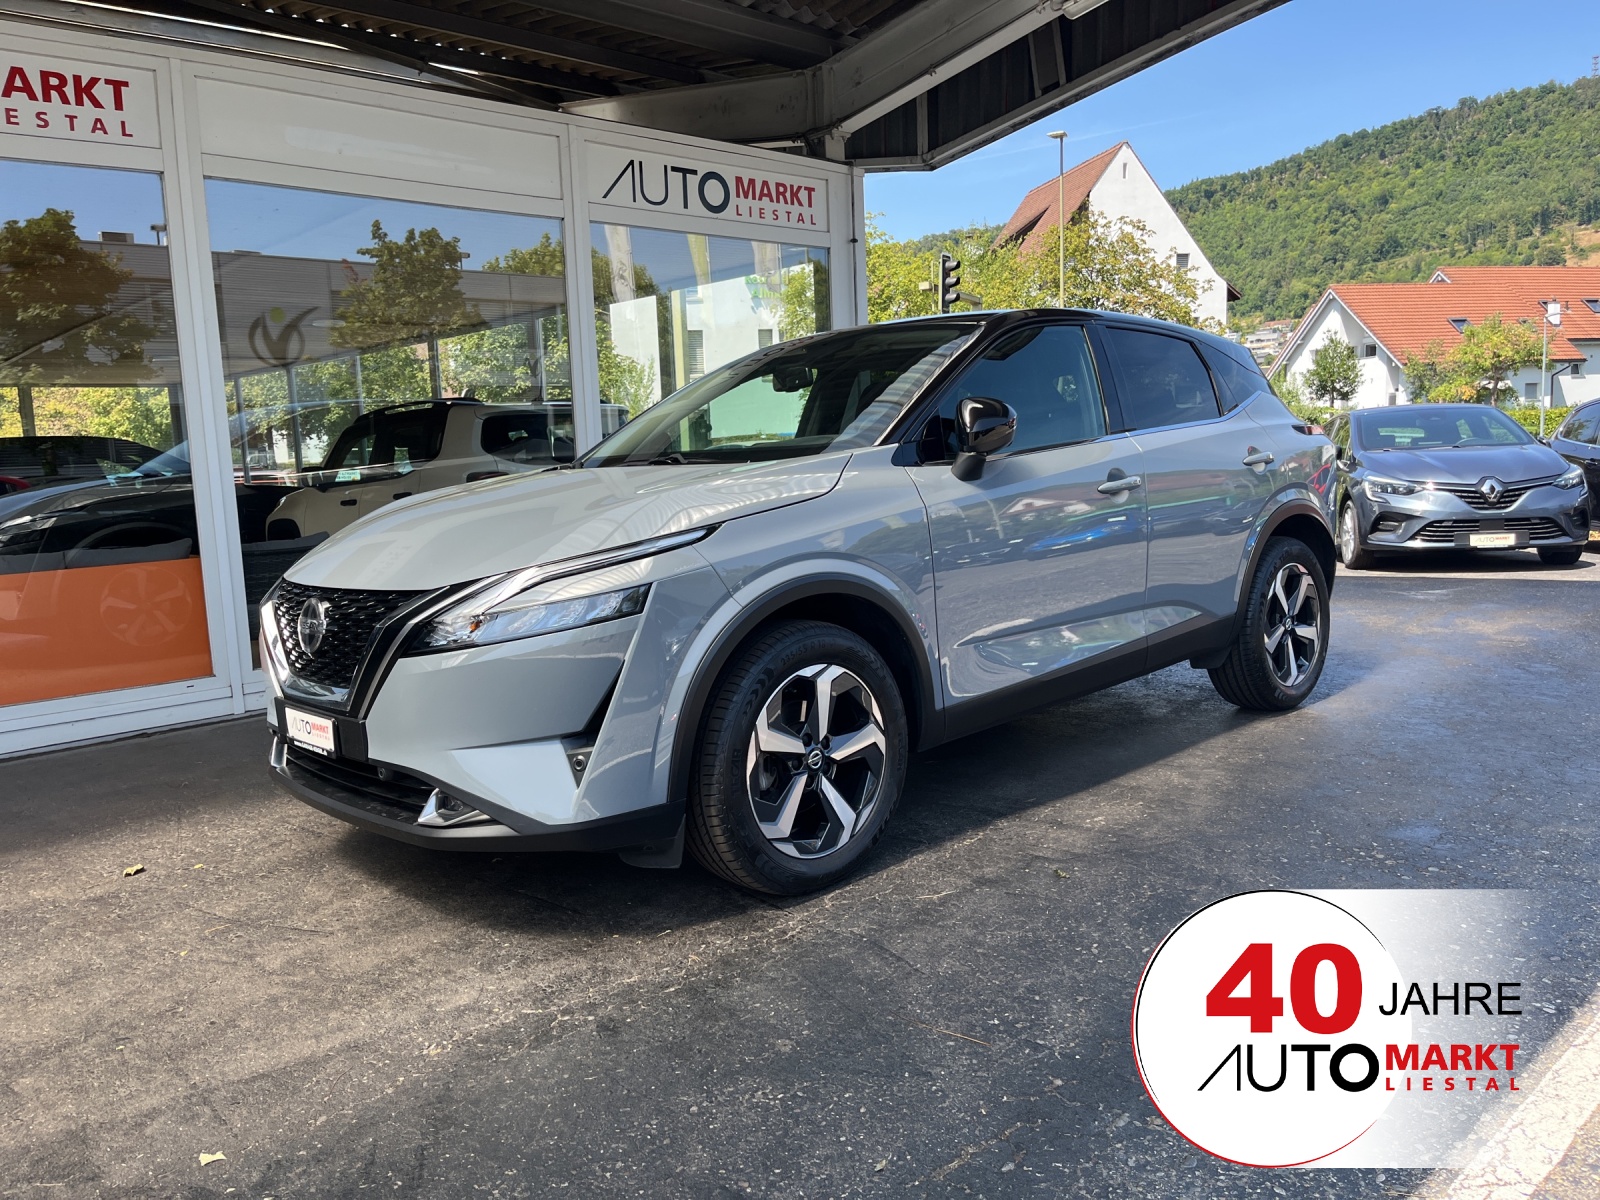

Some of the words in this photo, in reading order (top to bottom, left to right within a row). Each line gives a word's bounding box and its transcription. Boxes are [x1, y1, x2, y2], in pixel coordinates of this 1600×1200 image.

[0, 66, 130, 112] ARKT
[4, 107, 134, 138] ESTAL
[602, 159, 731, 214] AUTO
[734, 175, 816, 208] MARKT
[735, 204, 817, 226] LIESTAL
[292, 717, 311, 735] AUTO
[312, 722, 328, 734] MARKT
